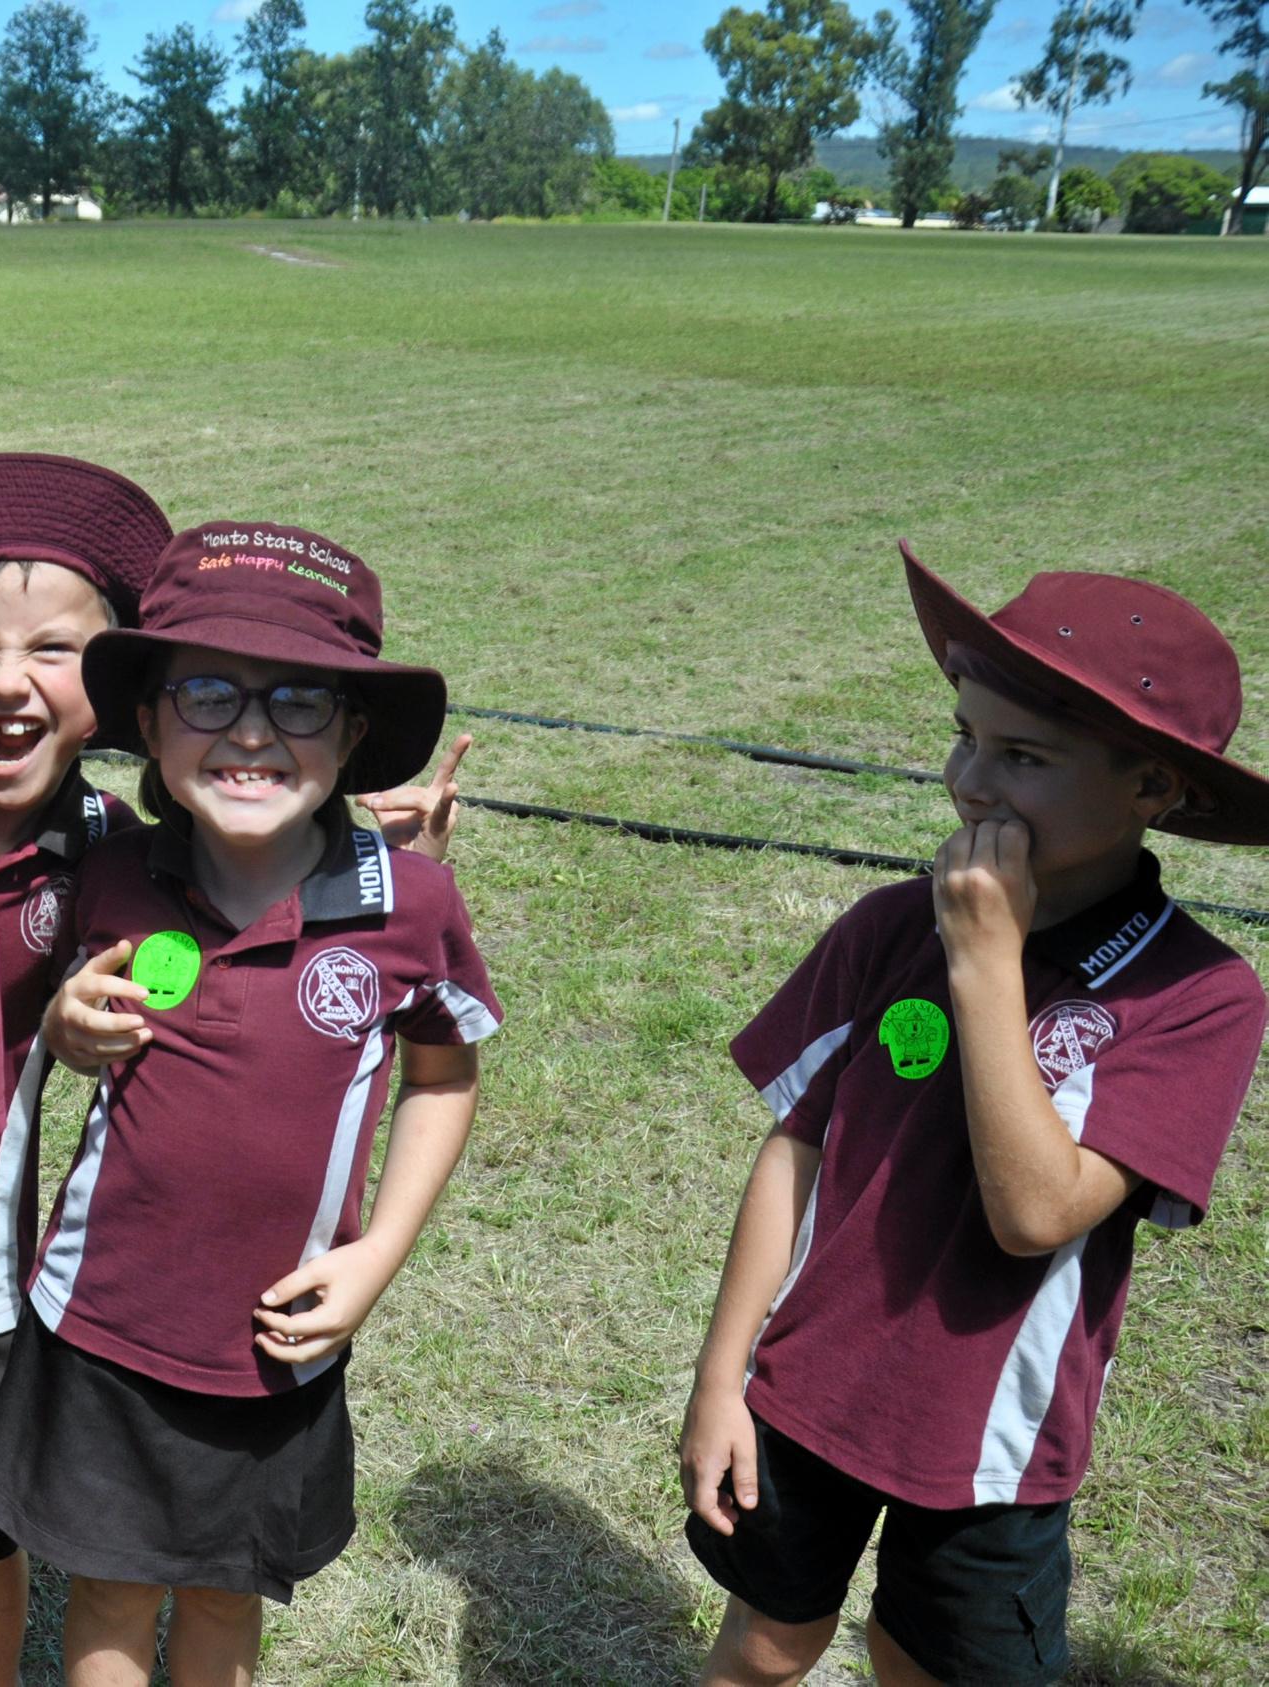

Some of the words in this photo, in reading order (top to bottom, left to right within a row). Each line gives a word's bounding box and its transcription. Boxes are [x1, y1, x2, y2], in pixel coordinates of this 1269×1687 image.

[203, 530, 249, 548] Monto
[253, 531, 304, 553] State
[309, 542, 351, 574] School
[234, 554, 284, 571] Happy
[287, 560, 348, 598] Learning
[352, 831, 382, 905] MONTO
[1079, 911, 1149, 976] MONTO
[332, 964, 366, 976] MONTO
[1072, 1015, 1109, 1036] MONTO
